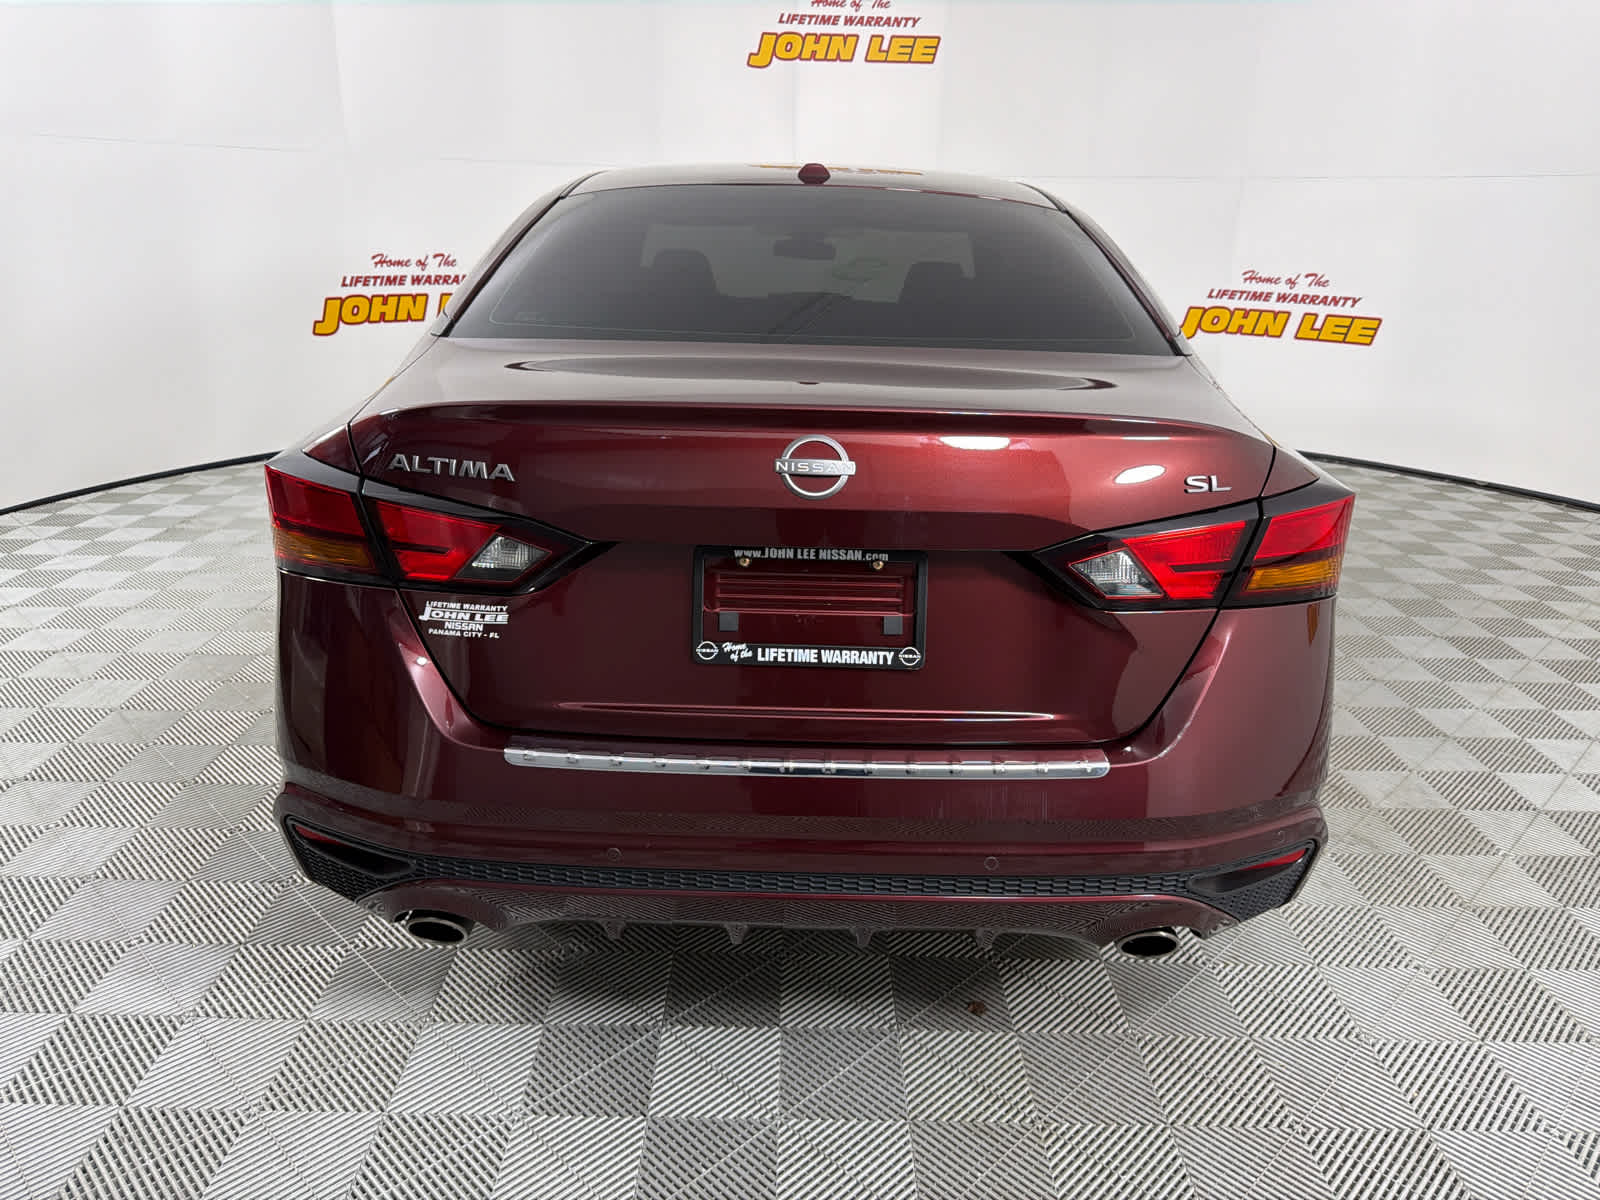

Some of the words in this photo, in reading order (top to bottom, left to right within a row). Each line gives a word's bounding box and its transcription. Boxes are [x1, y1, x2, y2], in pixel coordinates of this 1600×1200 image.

[778, 13, 841, 26] LIFETIME
[843, 15, 921, 28] WARRANTY
[747, 32, 859, 68] JOHN
[865, 34, 941, 64] LEE
[371, 253, 412, 268] Home
[415, 255, 429, 271] of
[432, 253, 457, 268] The
[341, 275, 407, 288] LIFETIME
[411, 274, 466, 286] WARRA
[1242, 270, 1281, 285] Home
[1285, 274, 1300, 290] of
[1304, 273, 1330, 288] The
[1207, 288, 1273, 303] LIFETIME
[1275, 292, 1362, 309] WARRANTY
[313, 293, 429, 336] JOHN
[1181, 306, 1291, 339] JOHN
[1294, 312, 1383, 346] LEE
[386, 453, 516, 482] ALTIMA
[775, 460, 855, 474] NISSAN
[1183, 474, 1232, 494] SL
[797, 548, 816, 559] LEE
[418, 606, 471, 621] JOHN
[474, 613, 509, 622] LEE
[426, 601, 461, 609] LIFETIME
[462, 603, 508, 611] WARRANTY
[428, 628, 461, 637] PANAMA
[444, 622, 484, 631] NISSAN
[757, 648, 818, 663] LIFETIME
[820, 649, 894, 665] WARRANTY
